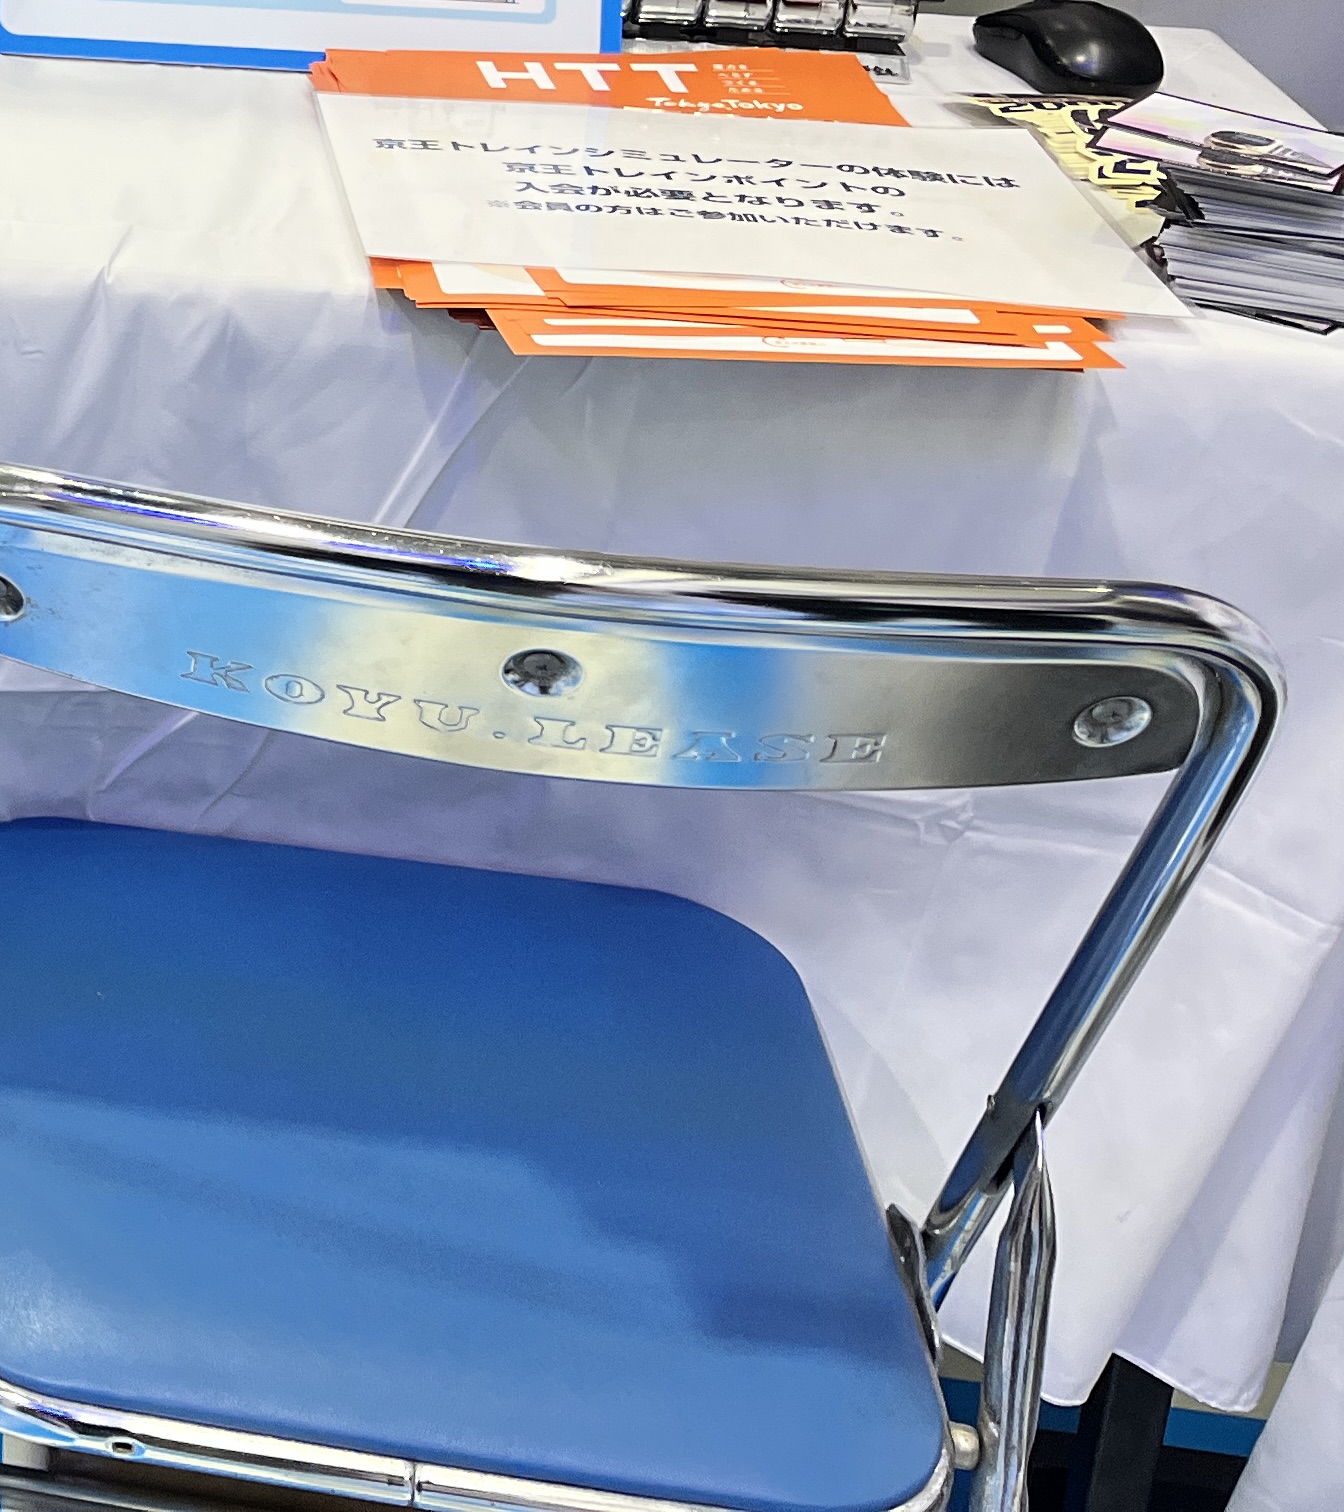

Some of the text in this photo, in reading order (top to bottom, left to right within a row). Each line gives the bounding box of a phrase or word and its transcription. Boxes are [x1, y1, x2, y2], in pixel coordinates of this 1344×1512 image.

[476, 60, 698, 94] HTT
[373, 138, 1020, 189] 京王トレインシミュレーターの体験には
[503, 161, 906, 198] 京王トレインポイントの
[515, 181, 904, 217] 入会が必要となります。
[179, 648, 892, 768] KOYU.LEASE
